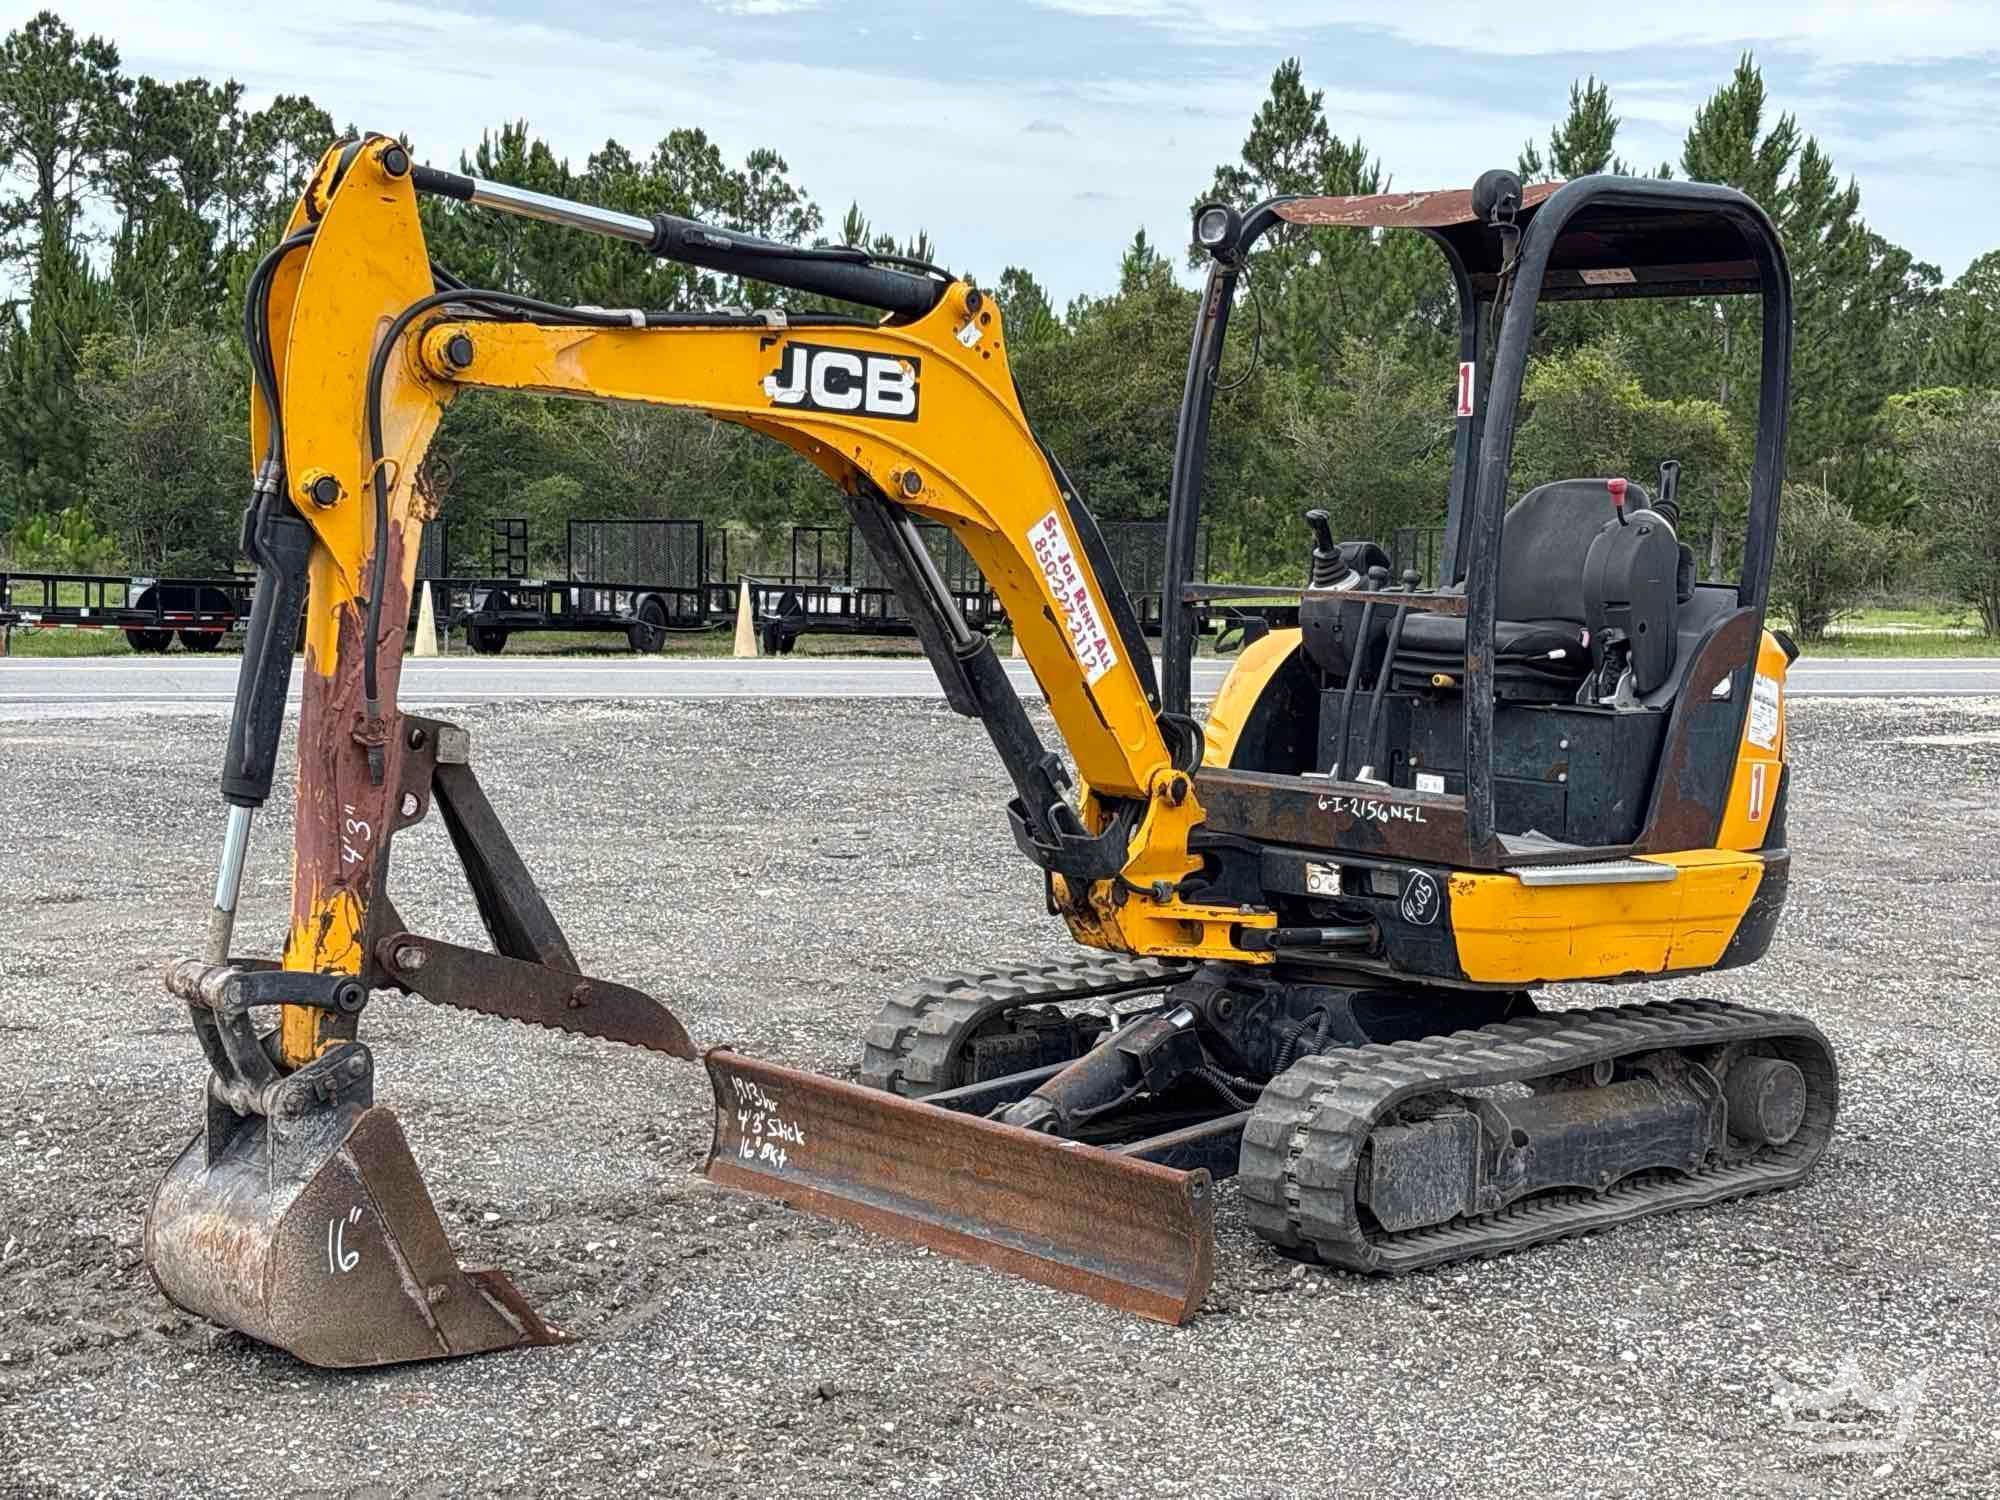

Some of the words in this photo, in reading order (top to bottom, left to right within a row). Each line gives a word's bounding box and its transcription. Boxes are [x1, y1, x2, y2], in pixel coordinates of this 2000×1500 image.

[763, 347, 916, 416] JCB
[1459, 364, 1472, 415] 1
[1034, 538, 1097, 671] 850-227-2112
[328, 1206, 362, 1274] 16"
